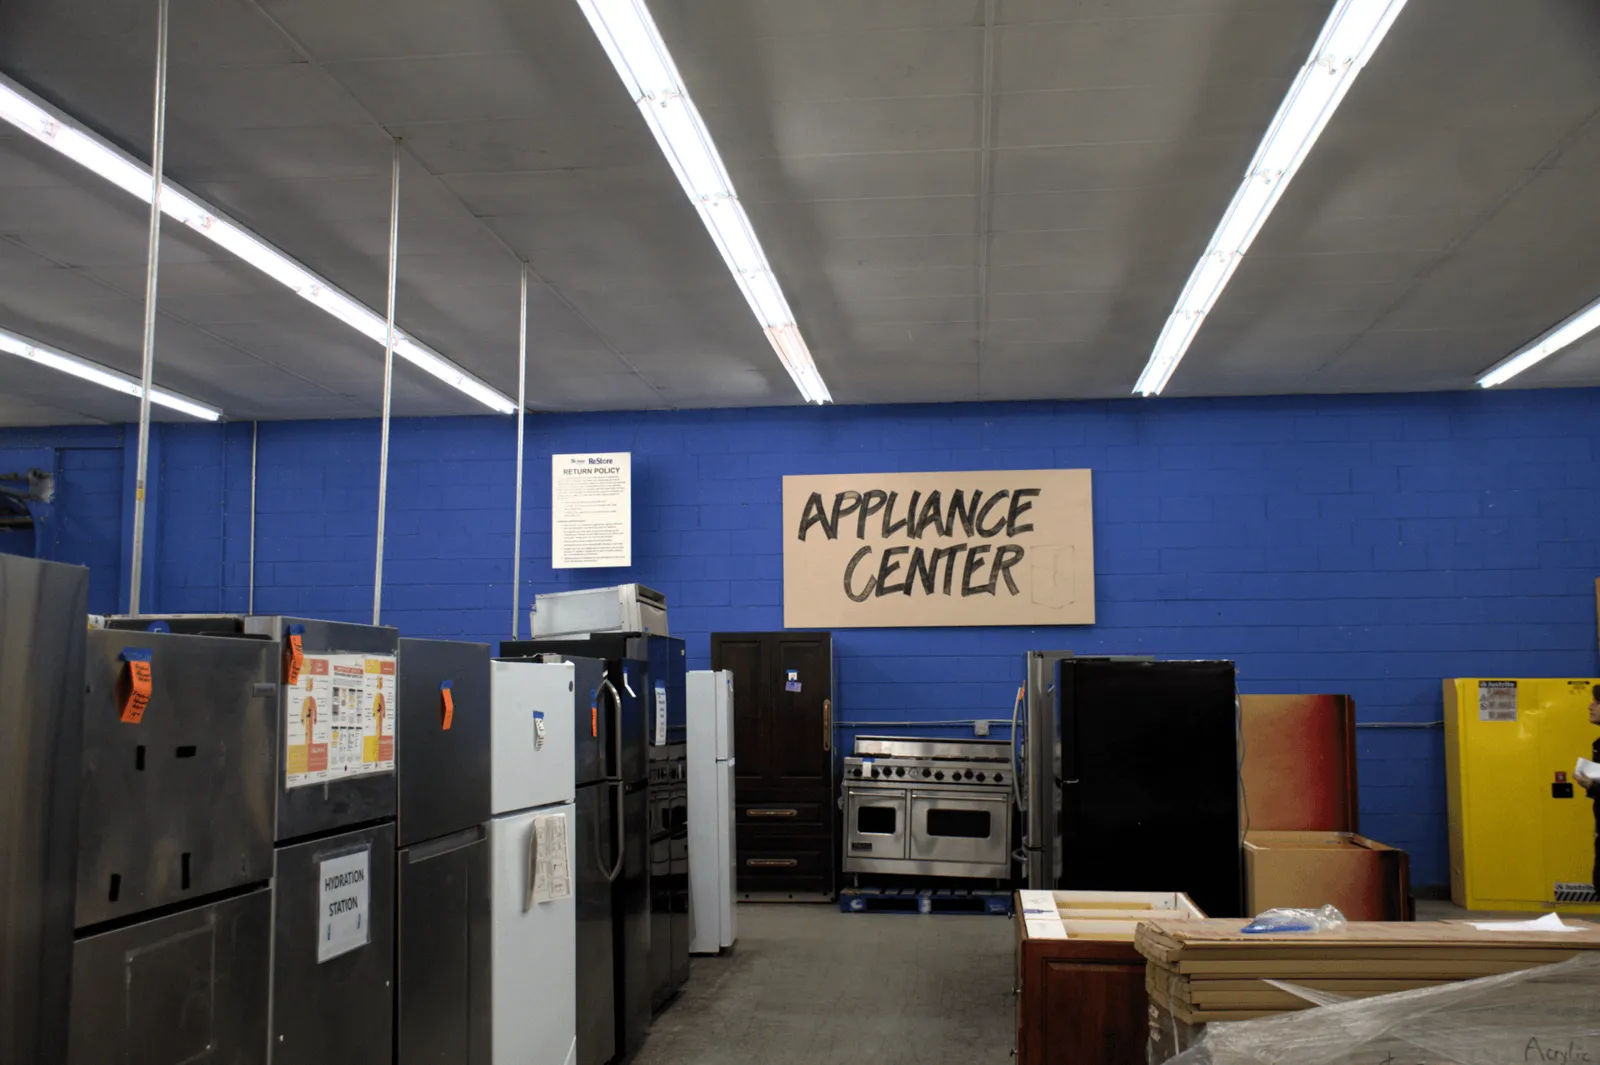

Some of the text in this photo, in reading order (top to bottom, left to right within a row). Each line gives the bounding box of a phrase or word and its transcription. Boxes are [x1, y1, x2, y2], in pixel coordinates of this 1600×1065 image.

[588, 457, 613, 465] ReStore
[798, 488, 1041, 542] APPLIANCE
[843, 543, 1025, 602] CENTER
[325, 869, 364, 891] HYDRATION
[329, 896, 358, 917] STATION
[1524, 1036, 1592, 1065] Acrylic
